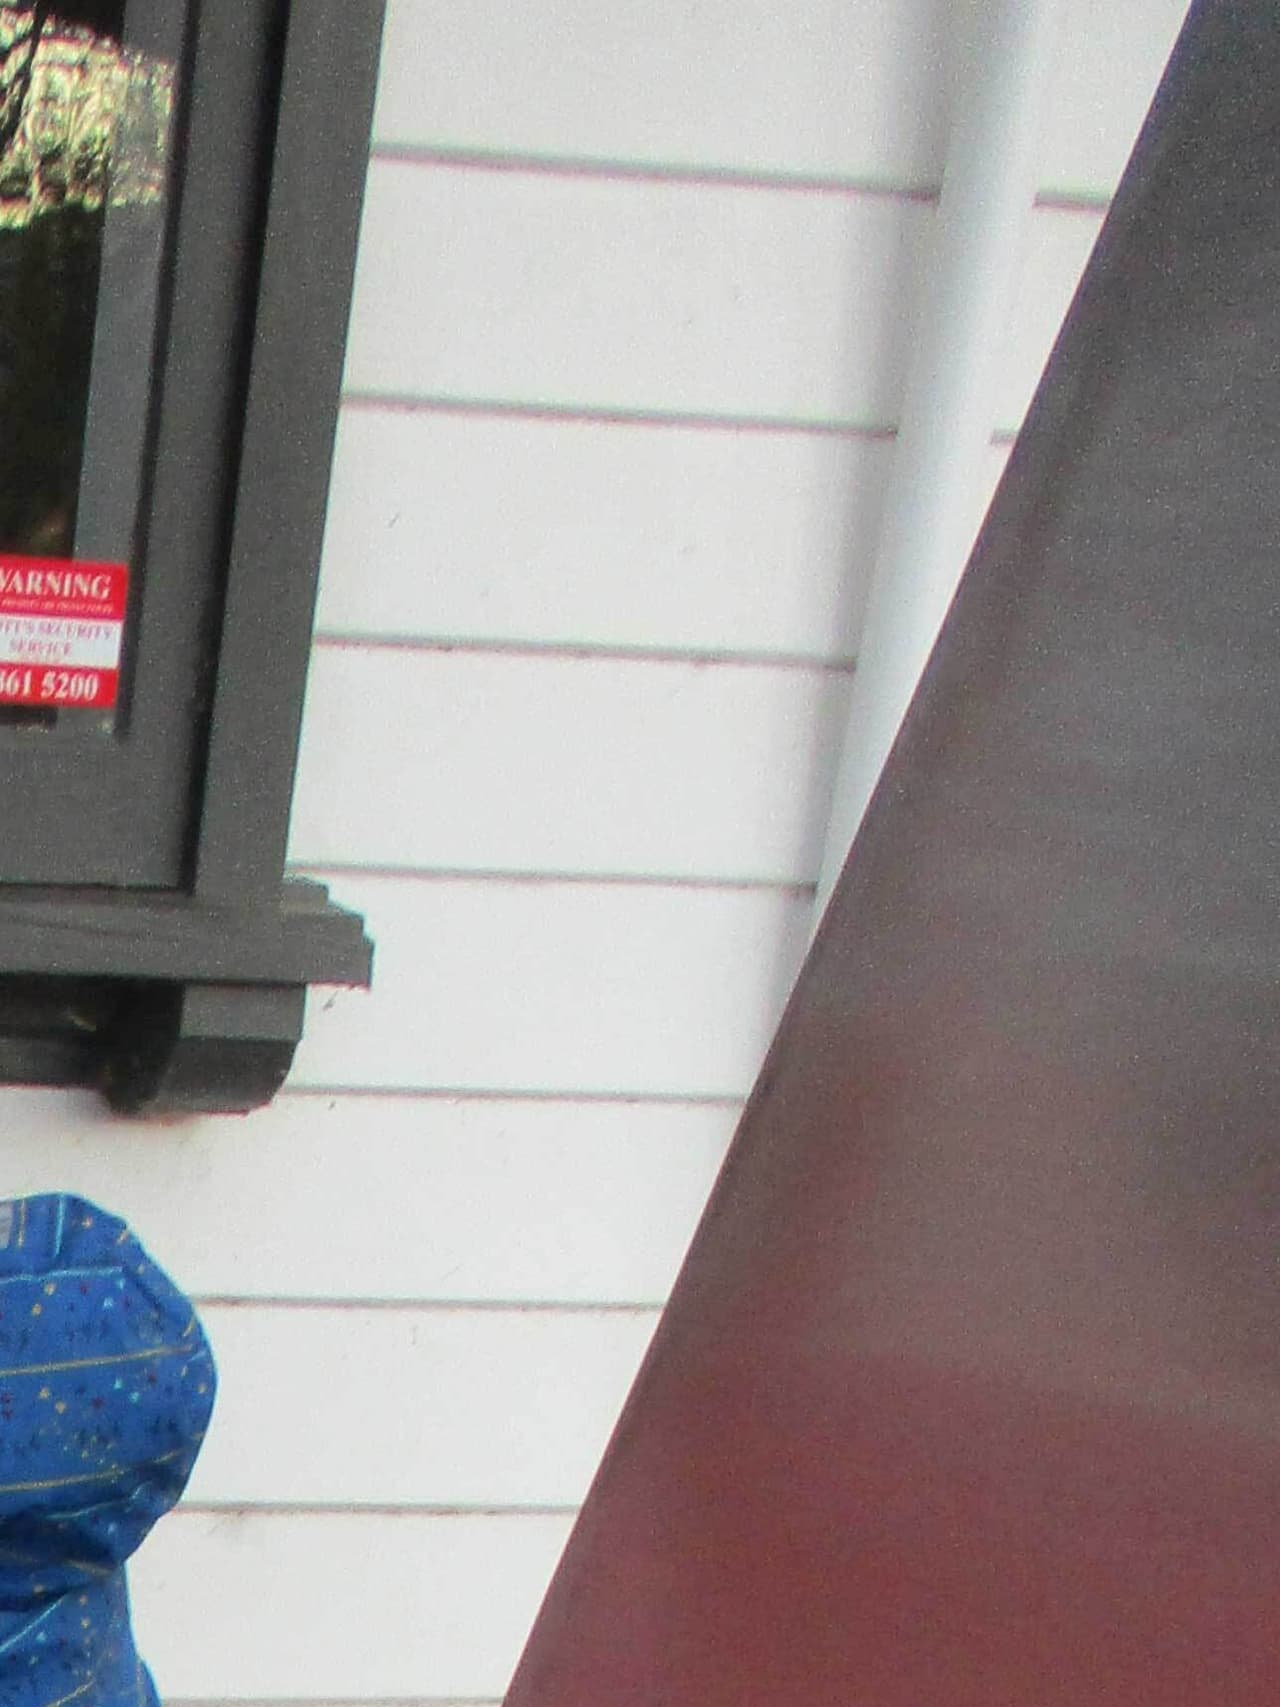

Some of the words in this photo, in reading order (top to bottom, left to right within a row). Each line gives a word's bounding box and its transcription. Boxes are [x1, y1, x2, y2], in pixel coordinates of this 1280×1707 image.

[37, 619, 113, 640] SECURITY
[9, 638, 72, 656] SERVICE
[40, 670, 100, 701] 5200
